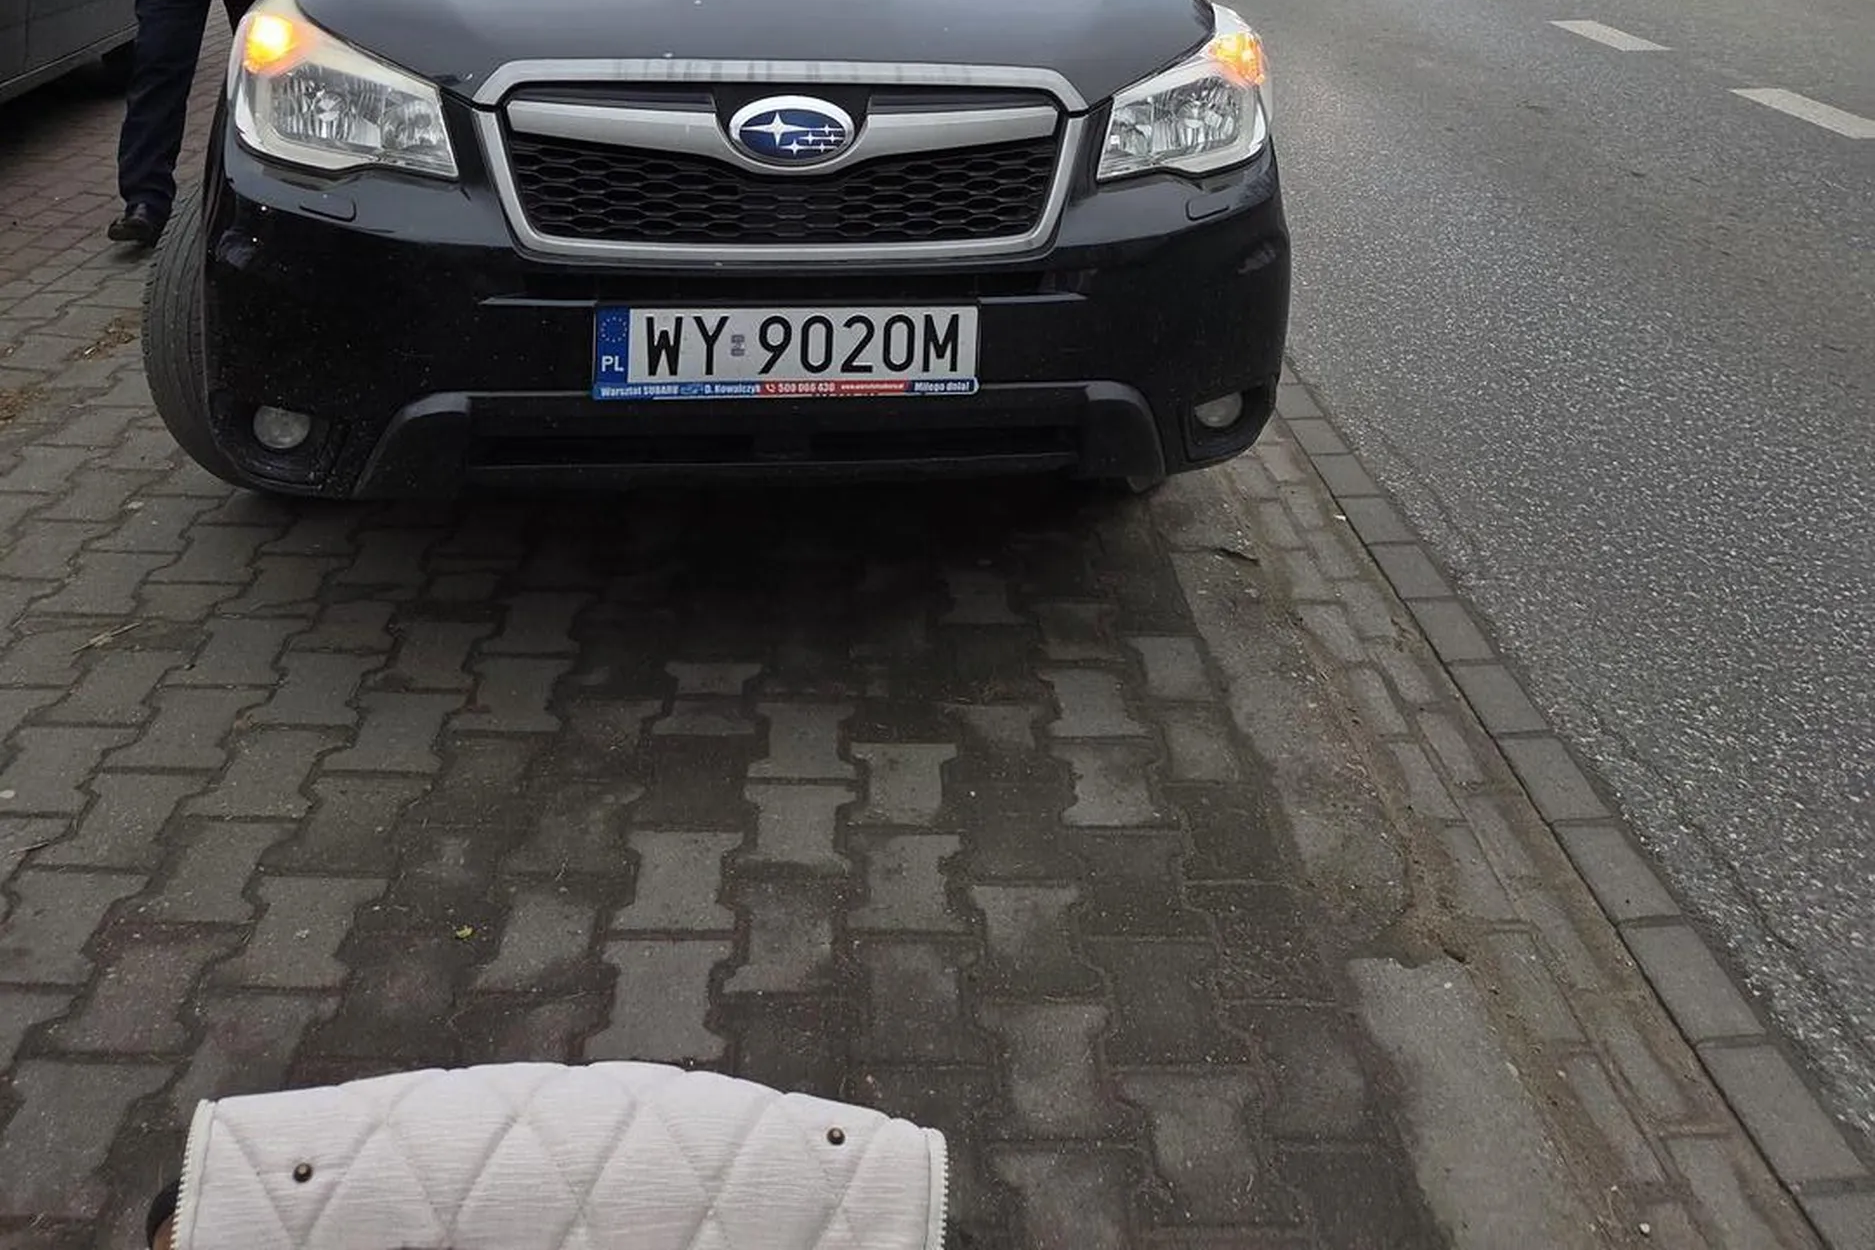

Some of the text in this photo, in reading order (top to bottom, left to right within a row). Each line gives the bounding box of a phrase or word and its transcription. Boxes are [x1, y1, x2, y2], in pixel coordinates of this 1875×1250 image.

[646, 313, 960, 377] WY 9020M
[601, 355, 624, 372] PL
[600, 385, 642, 397] Warsztat
